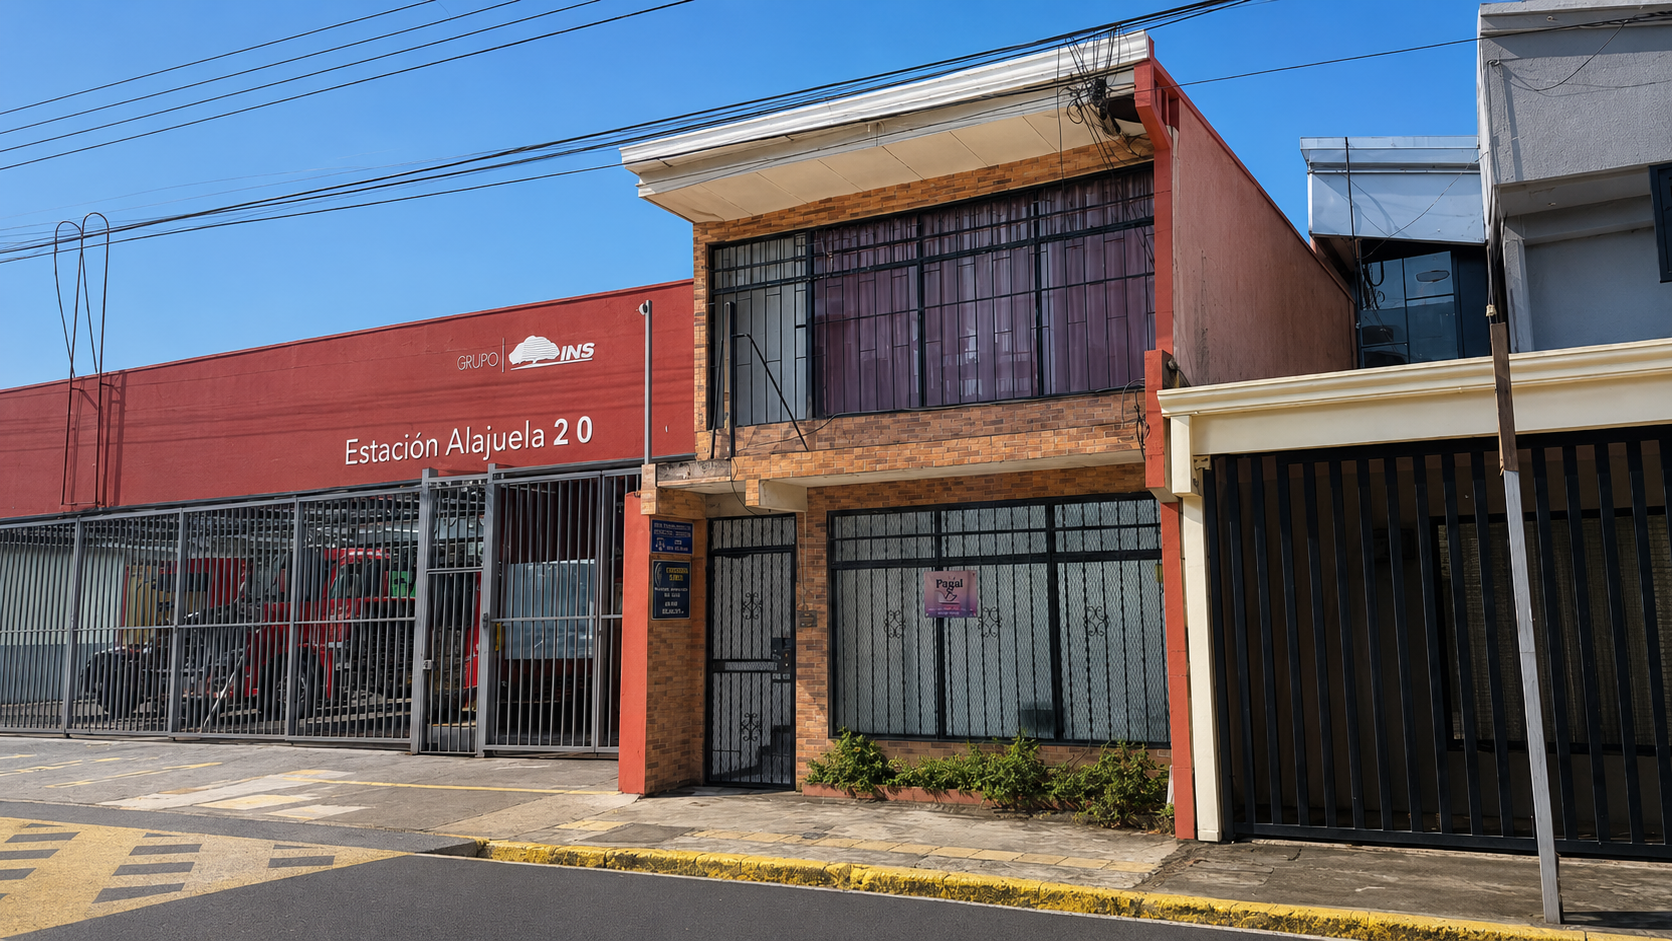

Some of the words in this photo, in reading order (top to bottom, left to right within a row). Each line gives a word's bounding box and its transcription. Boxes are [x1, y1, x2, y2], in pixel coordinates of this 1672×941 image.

[457, 351, 499, 371] GRUPO
[560, 342, 595, 362] INS
[345, 431, 438, 465] Estación
[446, 420, 545, 461] Alajuela
